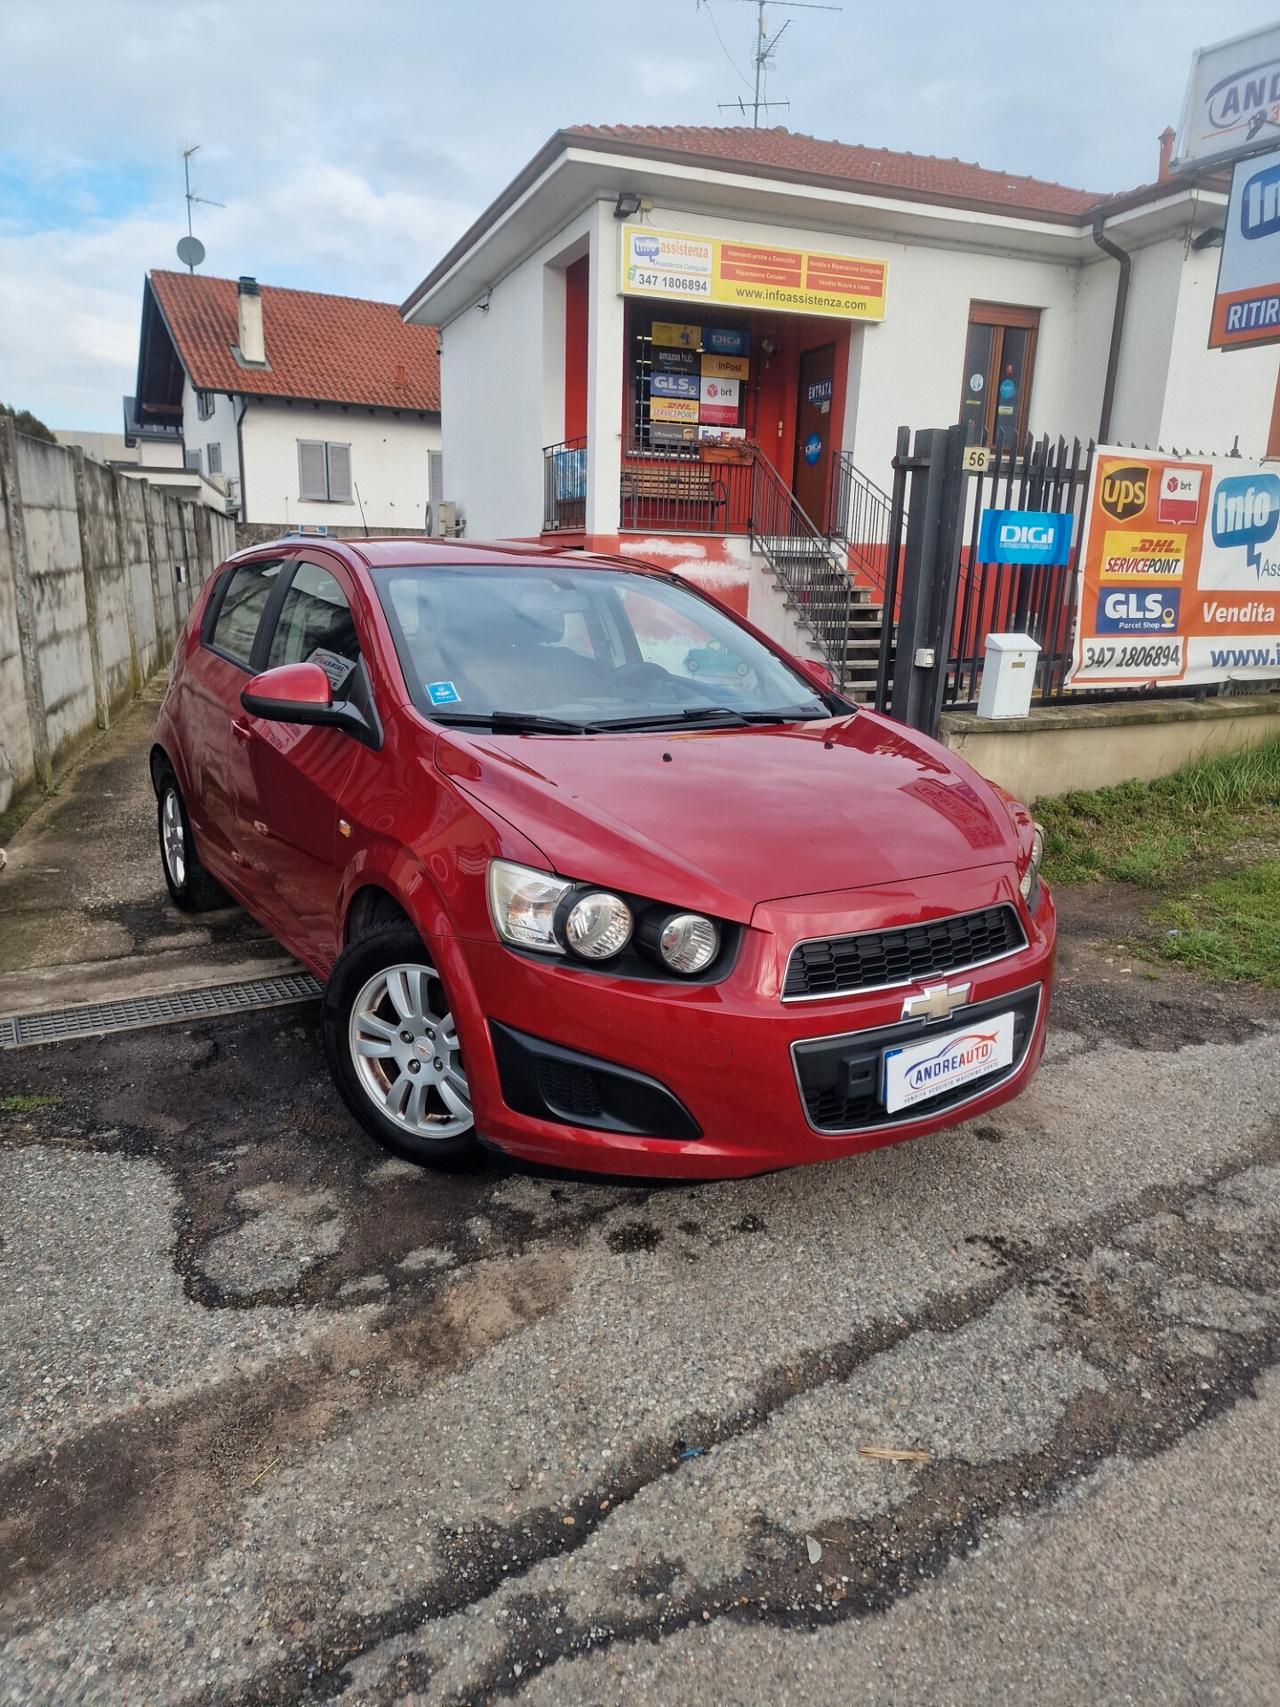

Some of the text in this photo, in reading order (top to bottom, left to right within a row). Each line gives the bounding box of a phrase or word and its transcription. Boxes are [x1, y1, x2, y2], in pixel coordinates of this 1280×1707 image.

[661, 241, 709, 258] assistenza
[638, 274, 707, 291] 347 1806894
[736, 288, 867, 310] www.infoassistenza.com
[1228, 298, 1280, 330] RITIR
[712, 335, 740, 345] DIGI
[659, 351, 694, 363] amazon hub
[719, 362, 741, 372] InPost
[654, 376, 688, 390] GLS
[720, 386, 733, 396] brt
[666, 402, 693, 410] DHL
[969, 451, 985, 467] 56
[1180, 480, 1192, 490] brt
[1104, 479, 1145, 513] ups
[1217, 486, 1271, 534] Info
[1000, 525, 1054, 544] DIGI
[1137, 539, 1176, 553] DHL
[1105, 557, 1181, 574] SERVICEPOINT
[1105, 593, 1162, 619] GLS
[1203, 602, 1275, 623] Vendita
[1143, 622, 1160, 630] Shop
[1085, 645, 1180, 669] 347 1806894
[915, 1043, 989, 1085] ANDREAUTO
